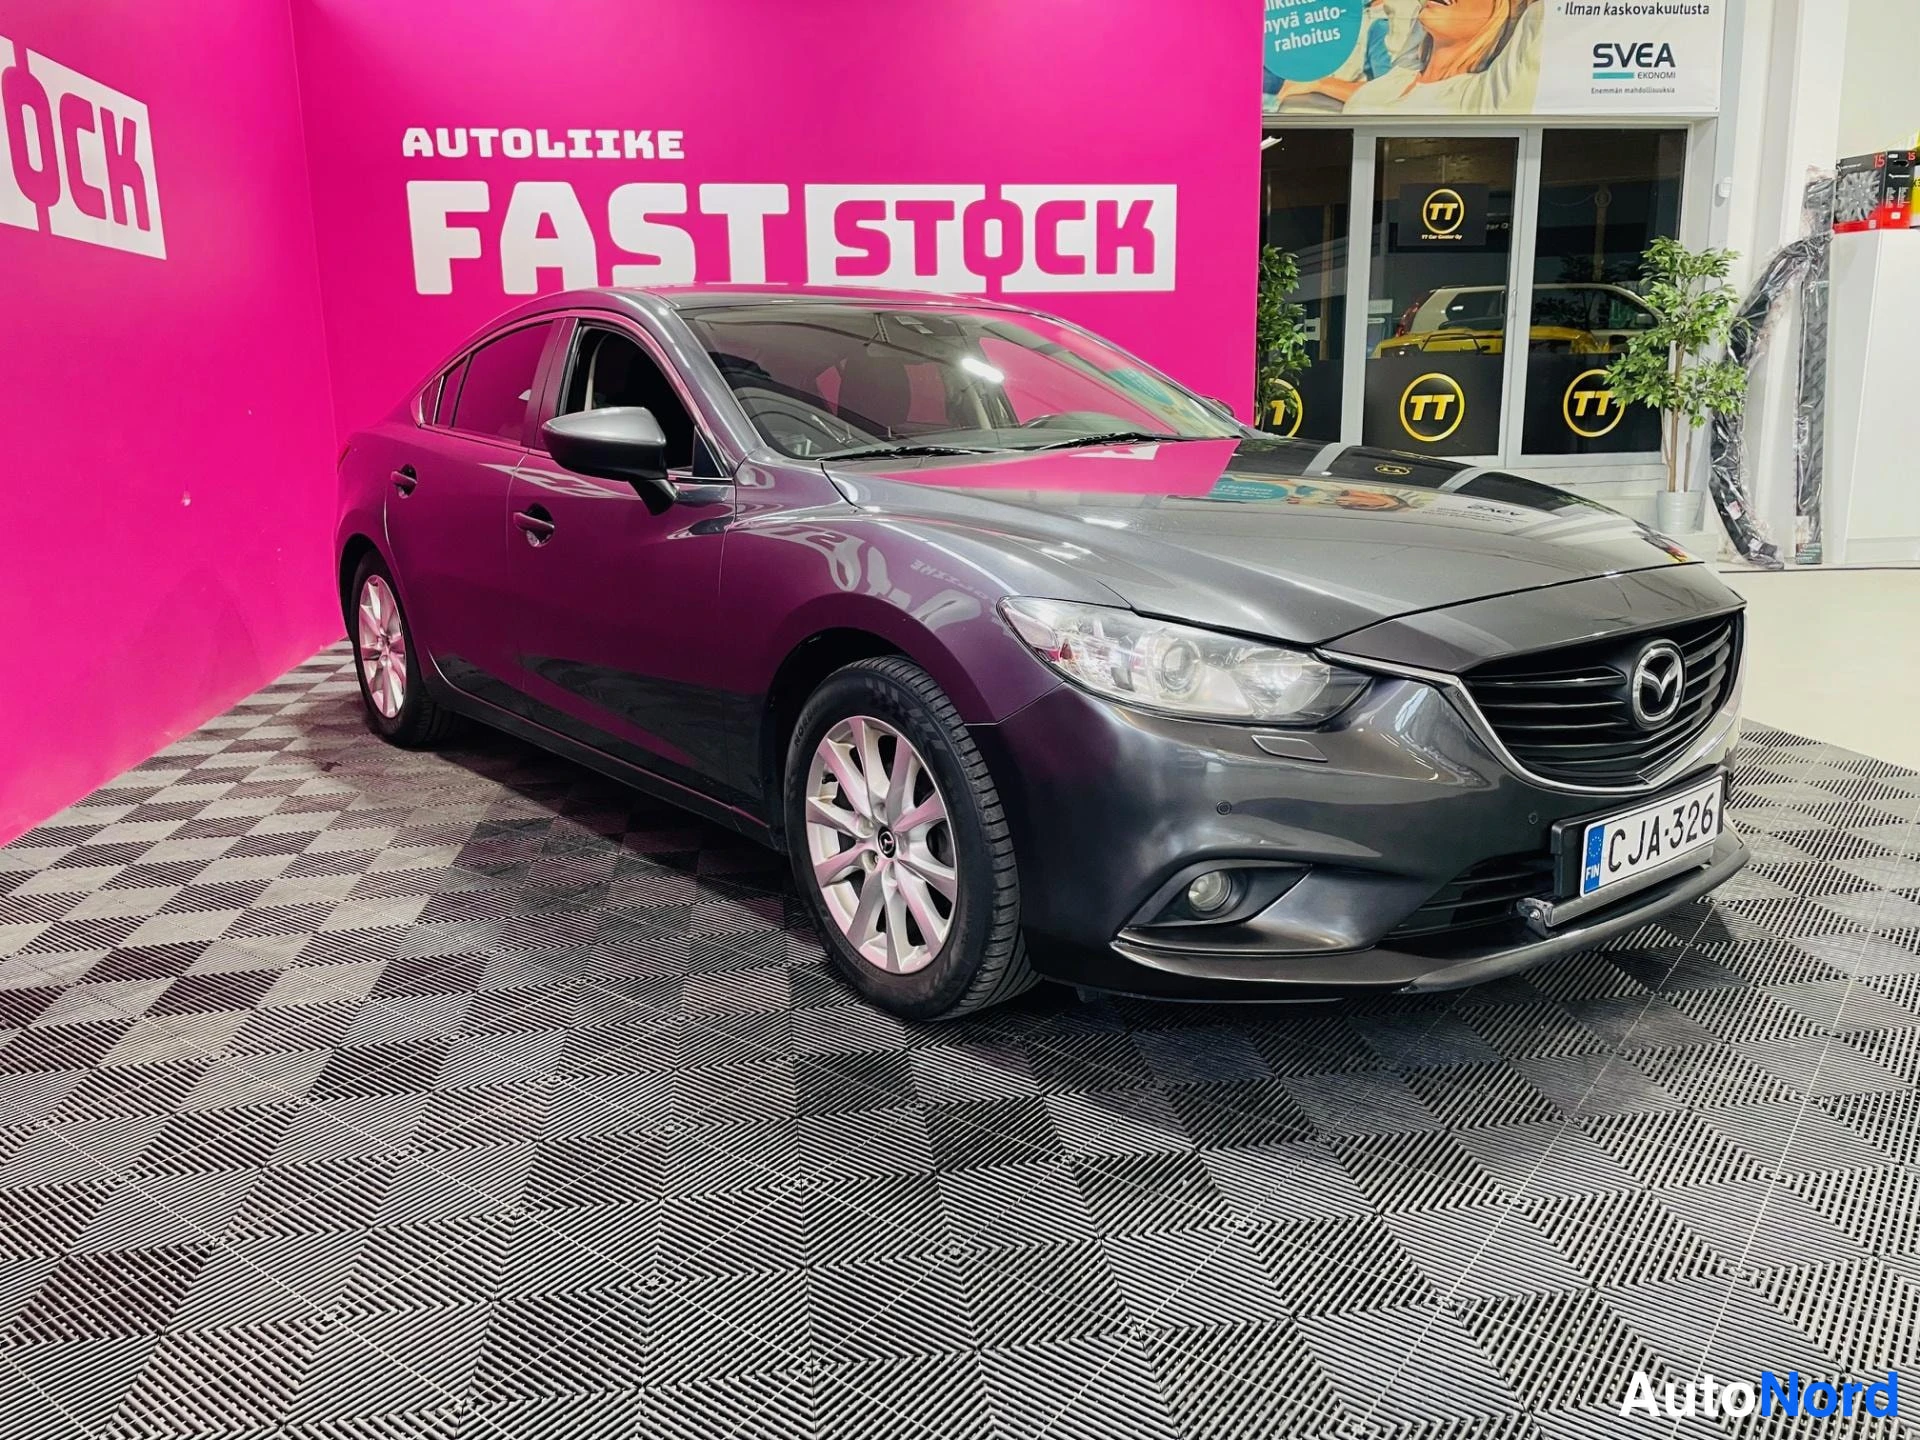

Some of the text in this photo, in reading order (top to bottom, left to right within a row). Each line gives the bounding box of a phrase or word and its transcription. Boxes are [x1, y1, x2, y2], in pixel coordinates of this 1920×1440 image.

[1304, 6, 1347, 24] auto-
[1565, 2, 1710, 16] Ilman kaskovakuutusta
[1274, 28, 1341, 52] rahoitus
[1592, 43, 1676, 68] SVEA
[1637, 71, 1676, 79] EKONOMI
[402, 127, 685, 160] AUTOLIIKE
[1874, 153, 1885, 169] 15
[1429, 202, 1458, 221] TT
[1410, 393, 1456, 421] TT
[1573, 390, 1616, 417] TT
[1608, 792, 1714, 872] CJA-326
[1586, 863, 1600, 881] FIN
